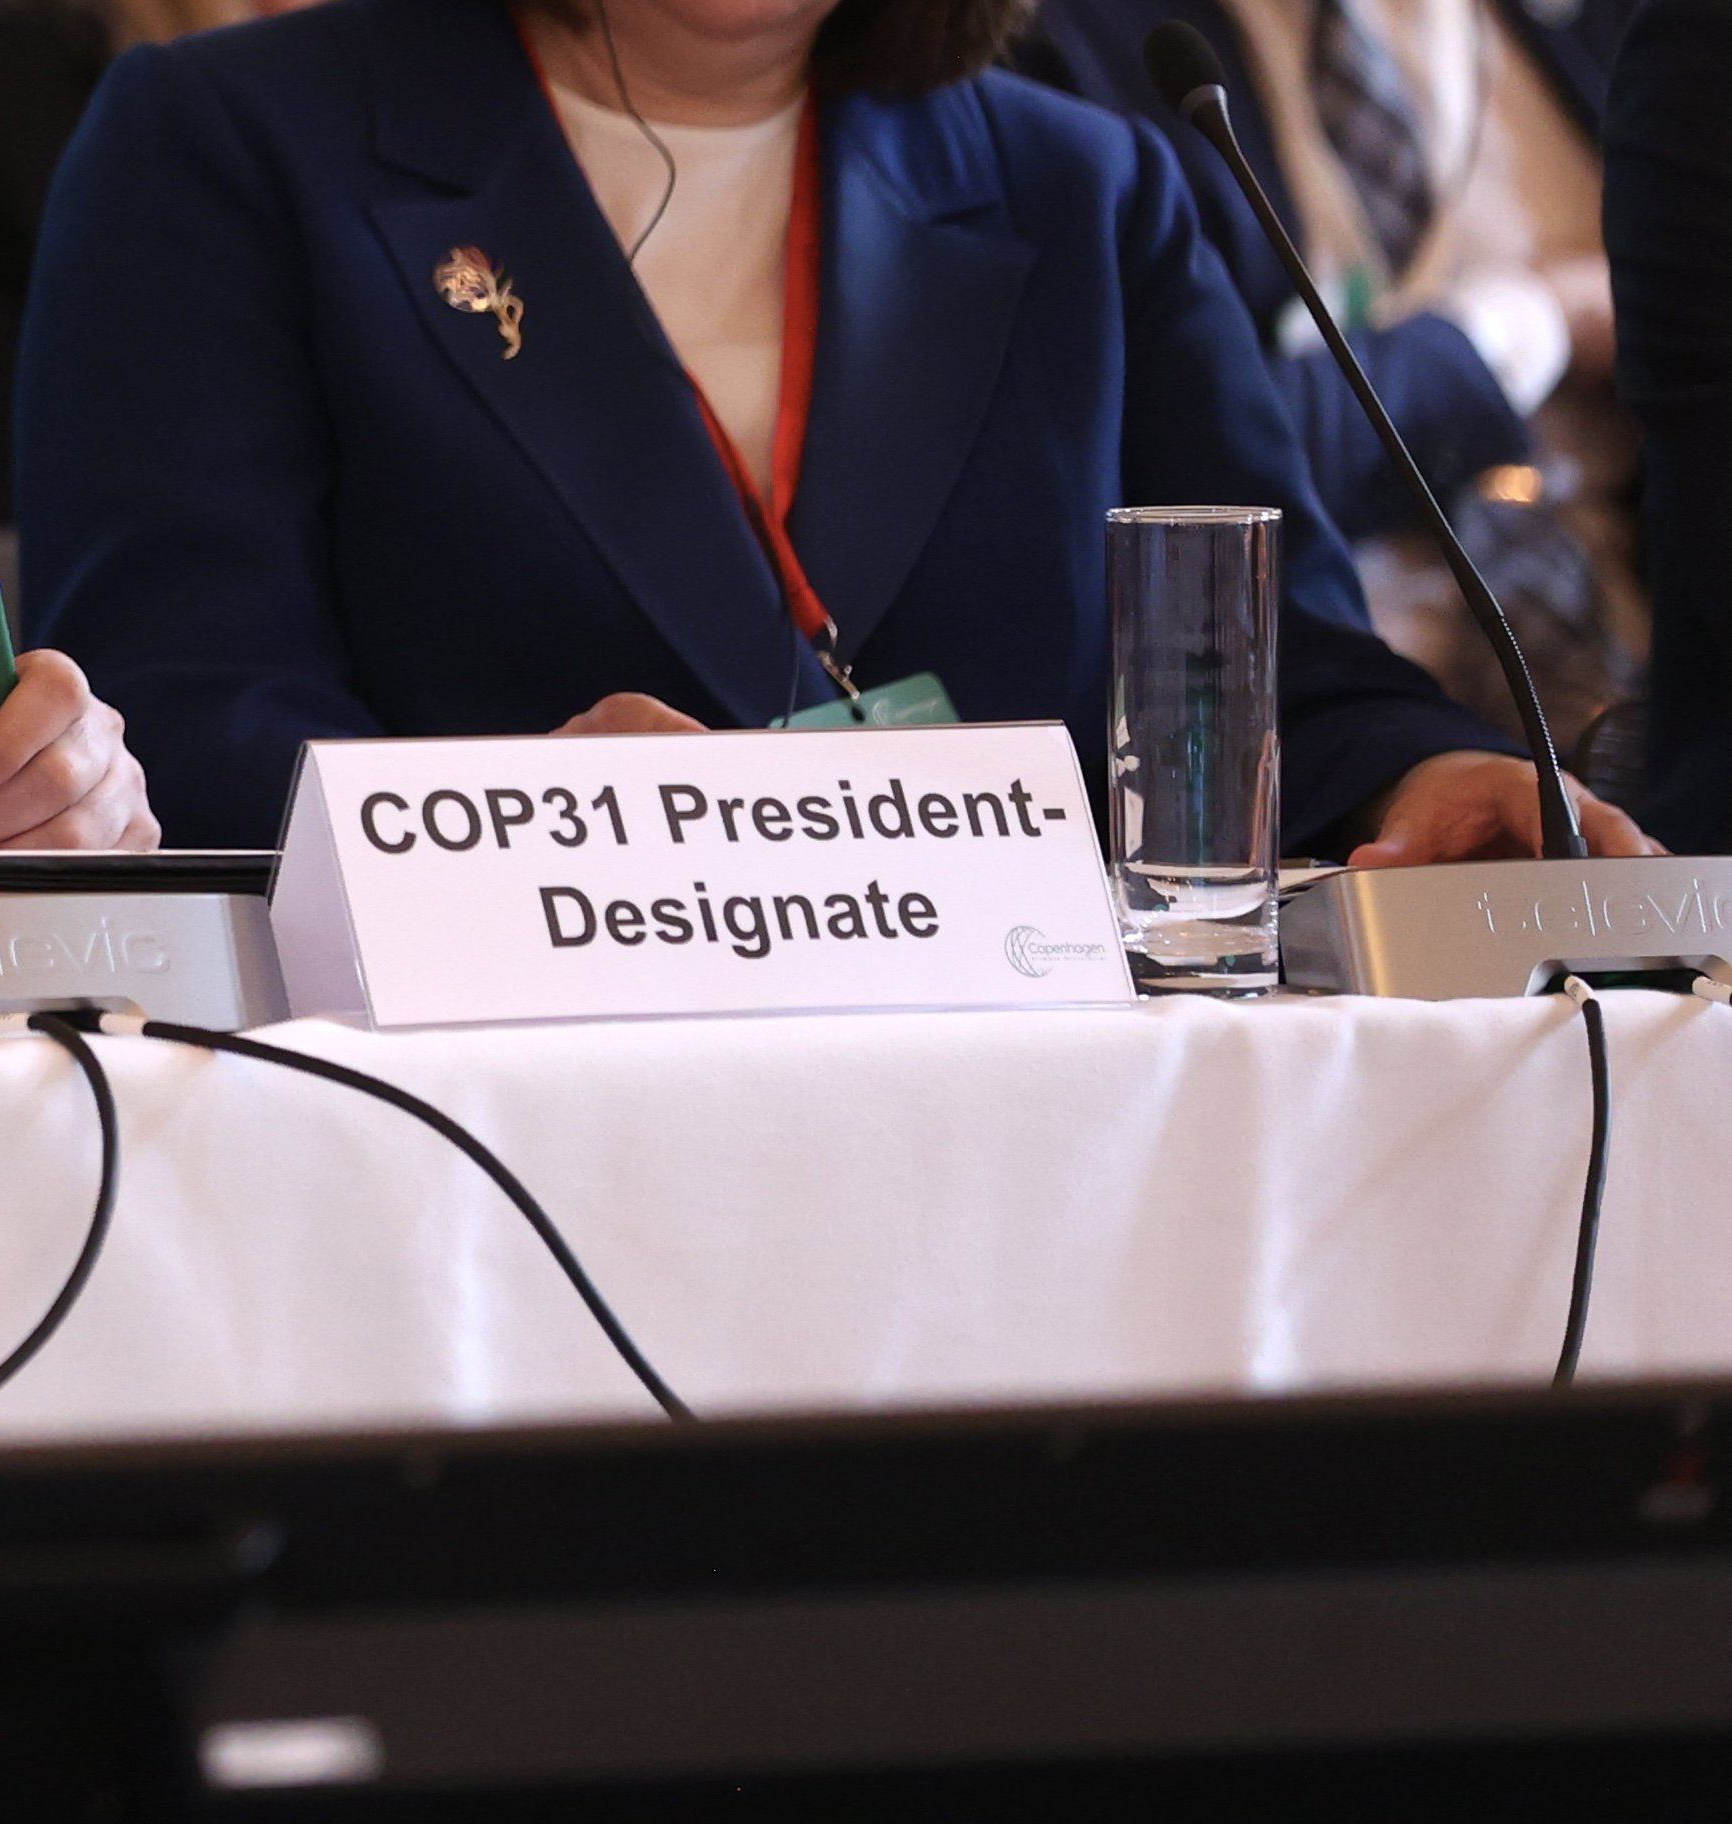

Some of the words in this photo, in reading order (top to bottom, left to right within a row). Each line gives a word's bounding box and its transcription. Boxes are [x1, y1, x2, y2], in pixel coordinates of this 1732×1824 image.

[360, 785, 629, 855] COP31
[658, 777, 1066, 844] President-
[539, 879, 939, 960] Designate
[1027, 940, 1106, 956] Copenhagen
